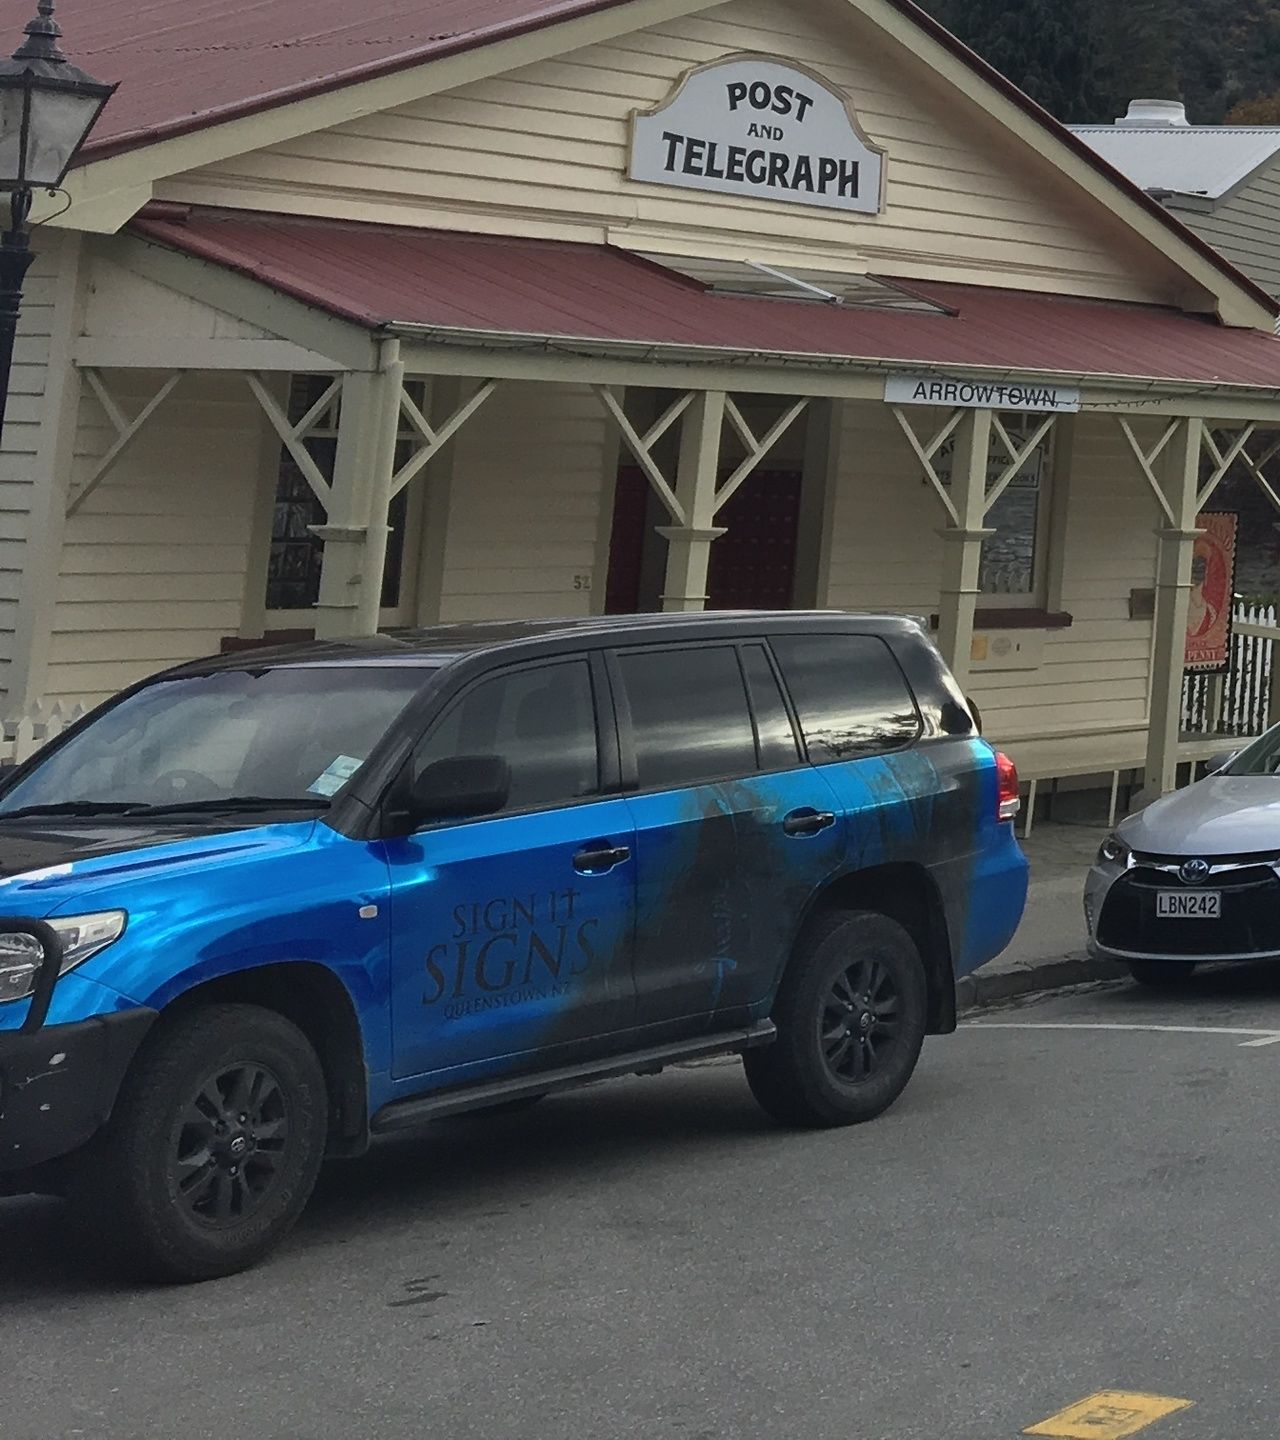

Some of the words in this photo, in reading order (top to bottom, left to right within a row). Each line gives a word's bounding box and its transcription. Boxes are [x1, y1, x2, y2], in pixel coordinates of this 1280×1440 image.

[726, 81, 814, 123] POST
[747, 123, 784, 142] AND
[662, 131, 860, 198] TELEGRAPH
[912, 381, 1057, 407] ARROWTOWN
[1187, 648, 1219, 661] PENNY
[452, 893, 537, 939] SIGN
[550, 886, 581, 924] IT
[1158, 895, 1217, 915] LBN242
[422, 917, 600, 1006] SIGNS
[442, 988, 549, 1021] QUEENSTOWN
